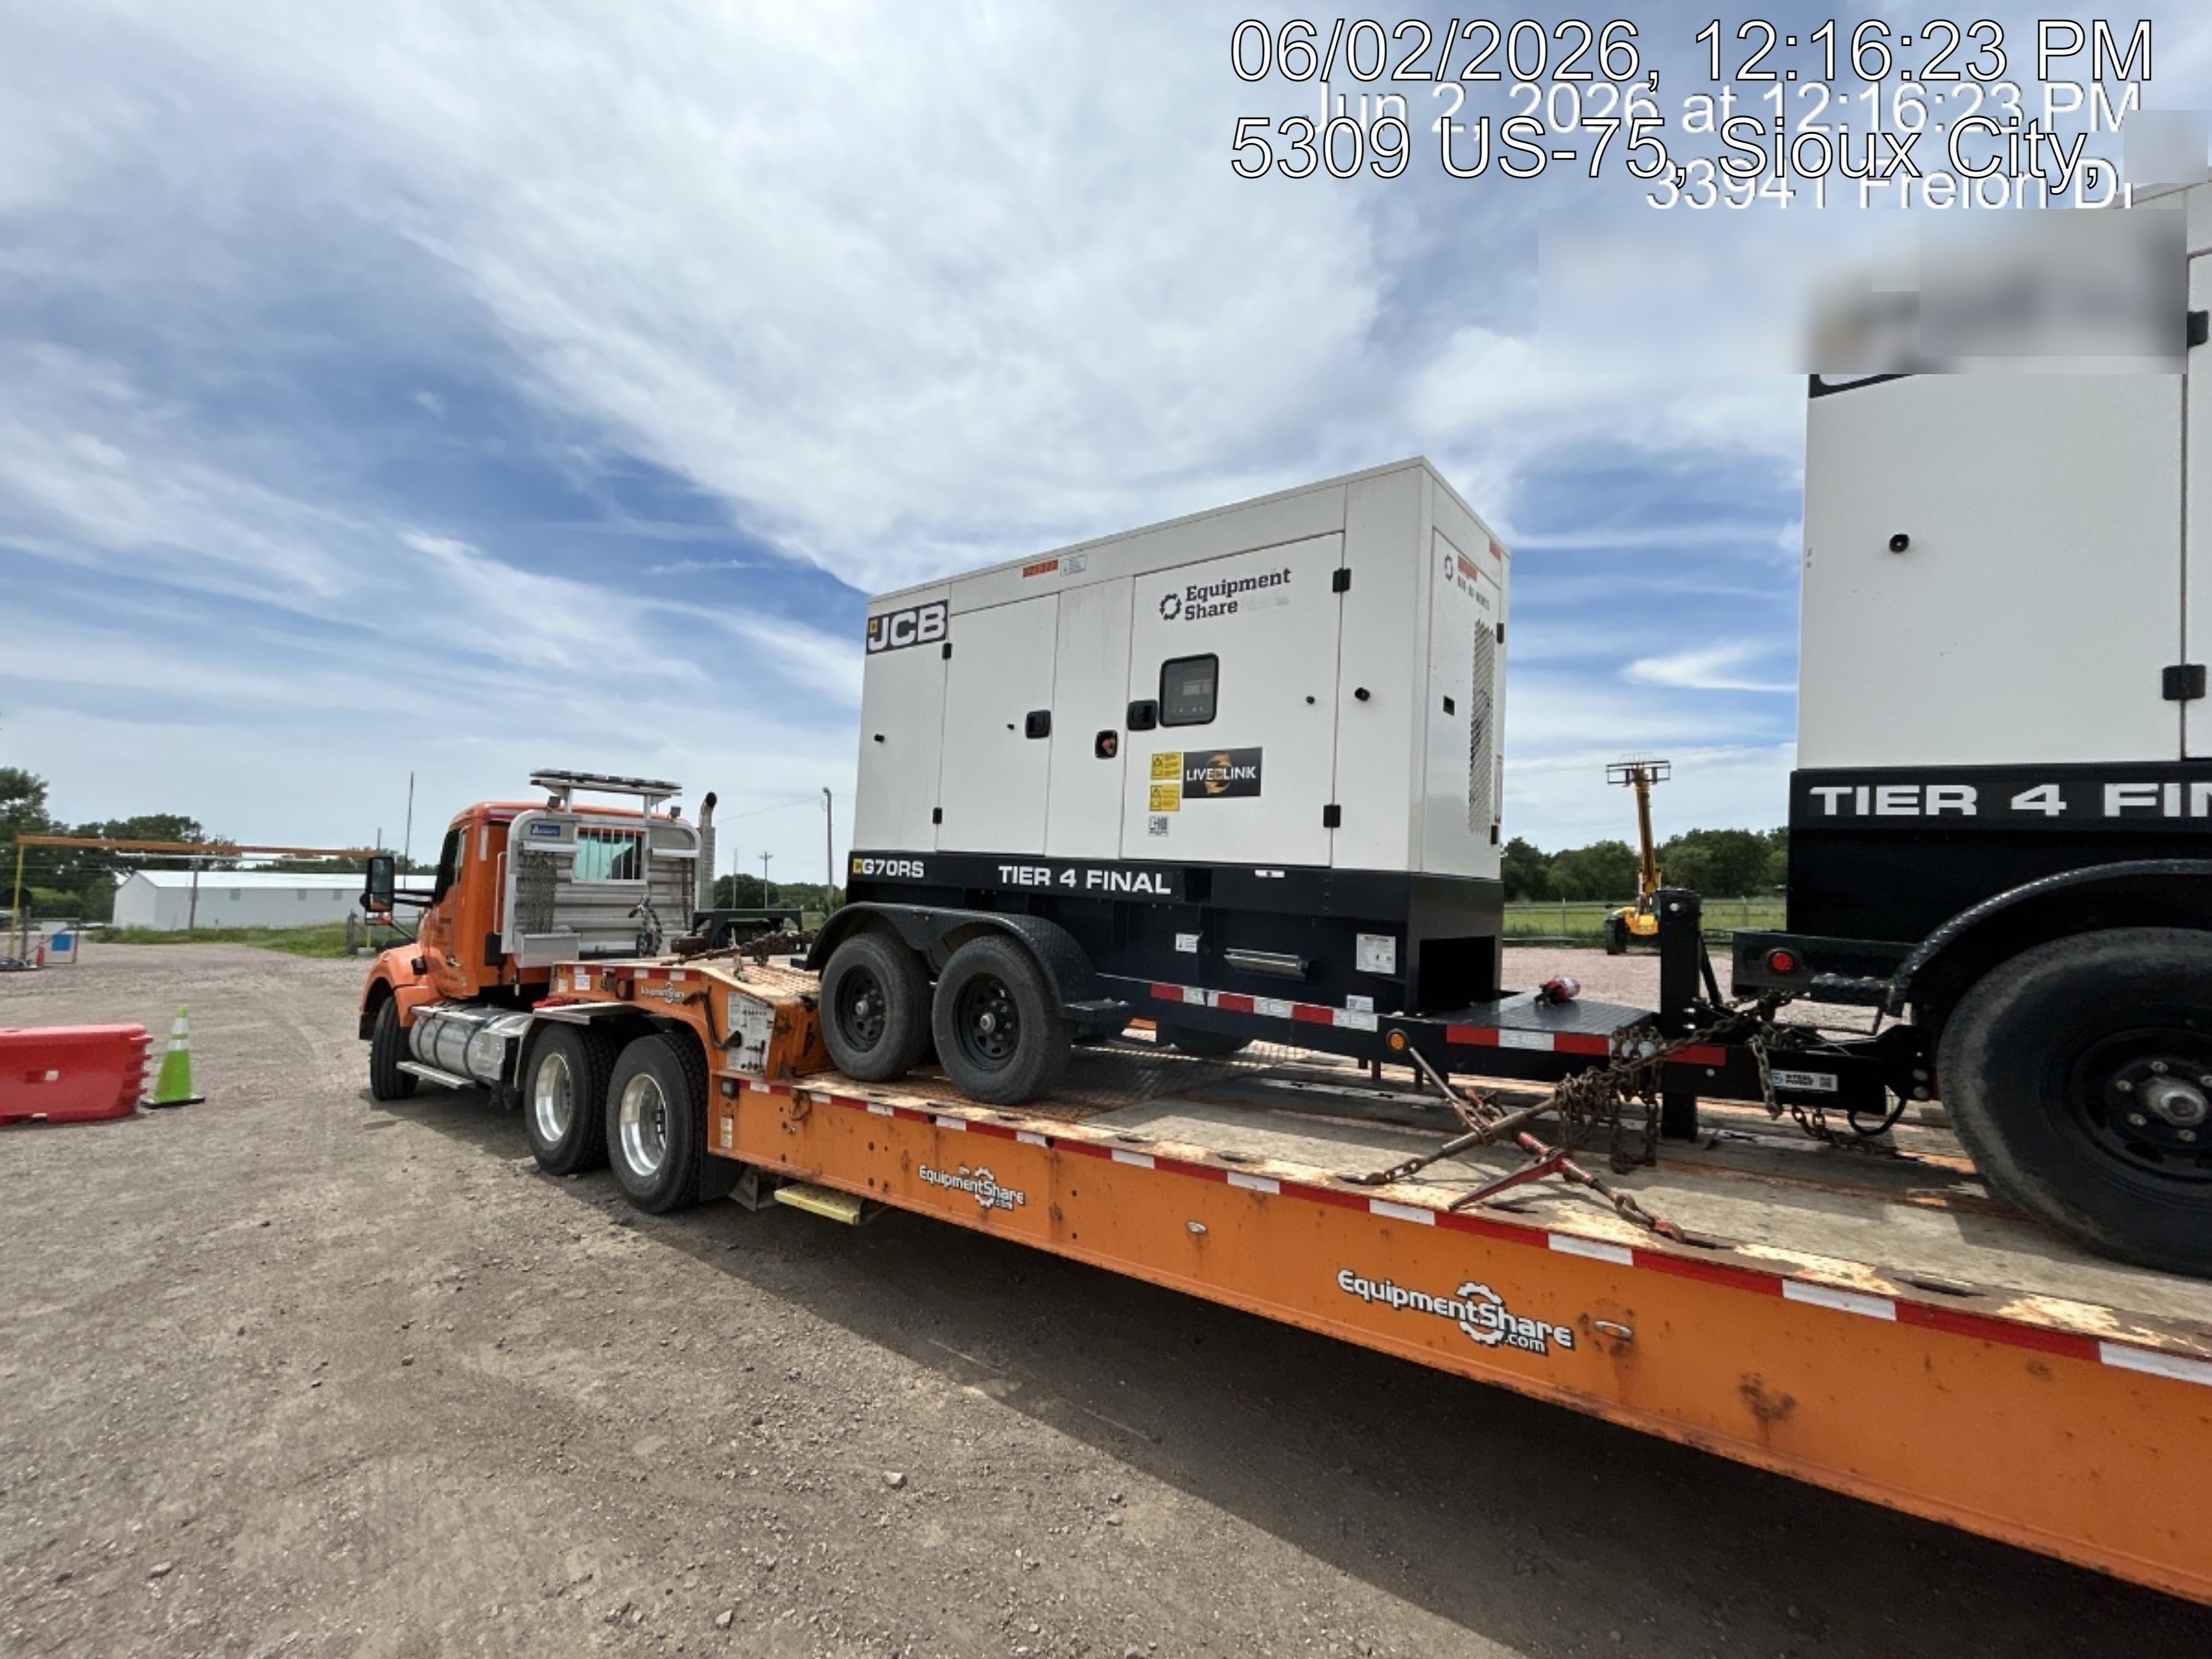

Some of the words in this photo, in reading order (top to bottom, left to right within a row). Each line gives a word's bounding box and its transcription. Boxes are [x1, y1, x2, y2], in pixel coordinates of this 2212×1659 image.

[1185, 567, 1292, 604] Equipment
[1185, 600, 1238, 621] Share
[868, 603, 946, 652] JCB
[1809, 785, 1977, 816] TIER
[2010, 784, 2067, 817] 4
[862, 858, 925, 879] G70RS
[998, 865, 1051, 886] TIER
[1059, 869, 1077, 888] 4
[1086, 869, 1172, 895] FINAL
[919, 1164, 1024, 1205] EquipmentShare
[1337, 1269, 1574, 1348] EquipmentShare
[1505, 1332, 1548, 1355] .com
